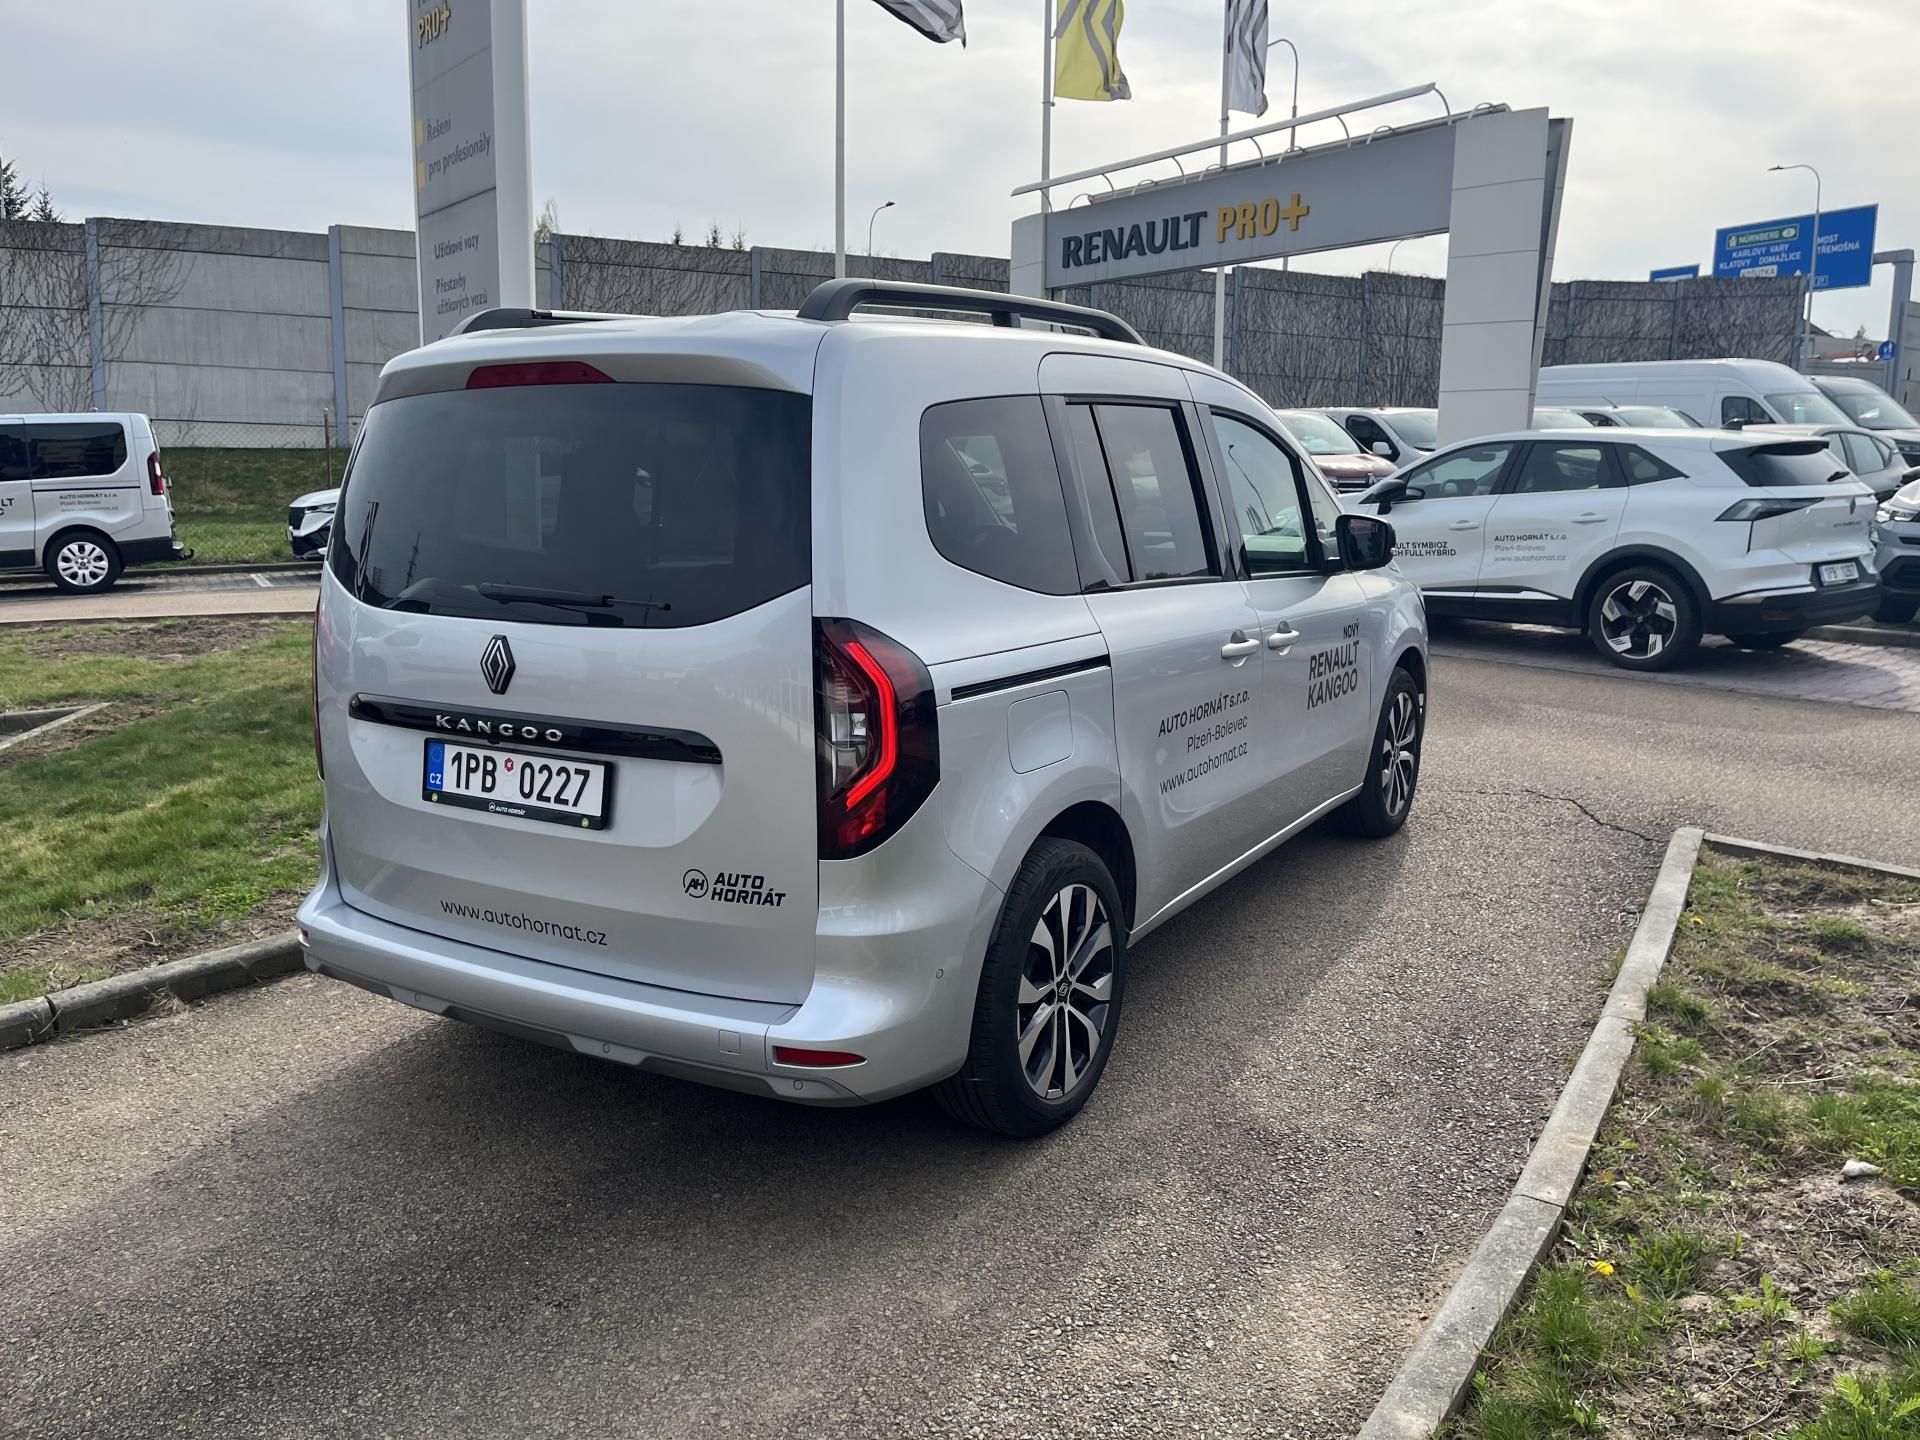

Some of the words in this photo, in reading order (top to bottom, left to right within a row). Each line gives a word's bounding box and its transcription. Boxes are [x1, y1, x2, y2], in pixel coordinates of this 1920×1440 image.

[417, 0, 451, 49] PRO+
[428, 159, 441, 181] pro
[443, 131, 491, 175] profesionály
[464, 234, 479, 251] vozy
[1062, 210, 1208, 269] RENAULT
[1216, 193, 1310, 244] PRO+
[1817, 233, 1839, 244] MOST
[1719, 259, 1752, 270] KLATOVY
[1758, 251, 1802, 265] DOMAŽLICE
[1732, 247, 1767, 259] KARLOVY
[1769, 243, 1790, 253] VARY
[1411, 541, 1448, 549] SYMBIOZ
[1494, 534, 1516, 542] AUTO
[1516, 532, 1549, 542] HORNÁT
[1550, 533, 1569, 541] s.r.o.
[1404, 549, 1424, 557] FULL
[1425, 548, 1457, 557] HYBRID
[1343, 618, 1360, 640] NOVÝ
[1308, 640, 1360, 681] RENAULT
[1307, 668, 1358, 710] KANGOO
[1158, 713, 1188, 738] AUTO
[1189, 692, 1230, 726] HORNÁT
[1229, 689, 1250, 708] s.r.o.
[435, 714, 563, 742] KANGOO
[1187, 715, 1248, 753] Plzeň-Bolevec
[429, 772, 442, 785] CZ
[451, 751, 498, 794] 1PB
[519, 761, 591, 807] 0227
[1160, 741, 1248, 795] www.autohornat.cz
[713, 871, 765, 890] AUTO
[711, 887, 786, 907] HORNÁT
[440, 899, 608, 946] www.autohornat.cz
